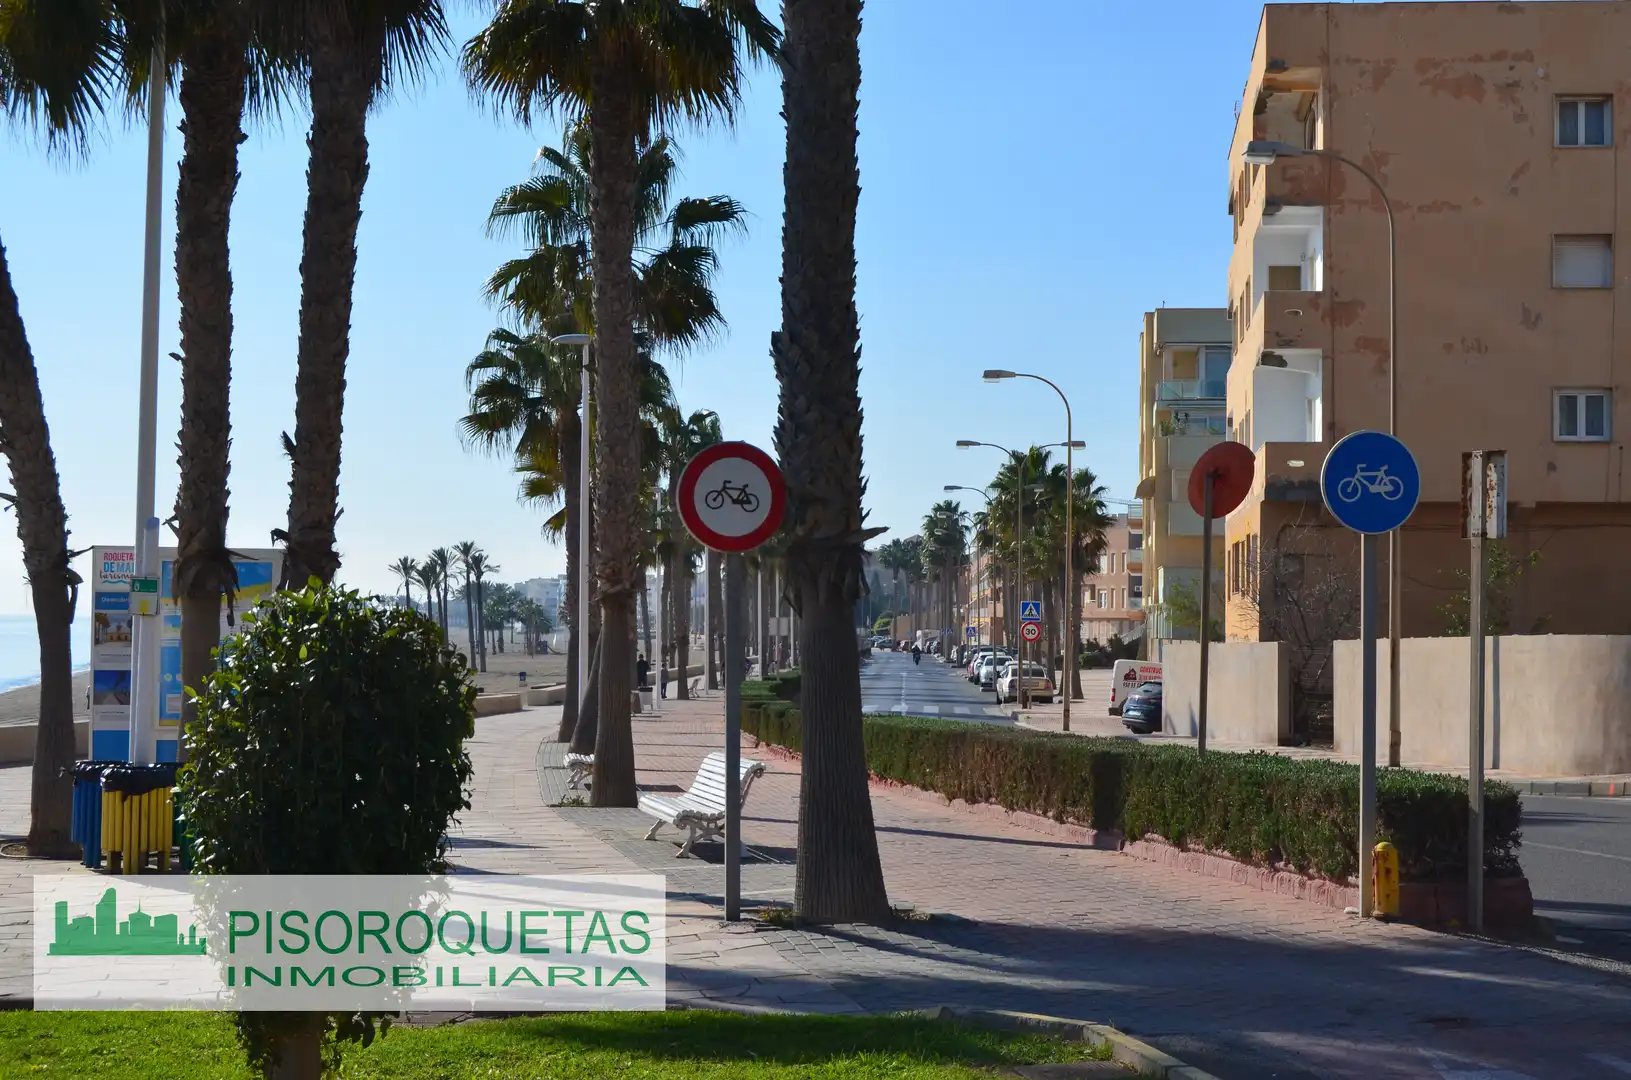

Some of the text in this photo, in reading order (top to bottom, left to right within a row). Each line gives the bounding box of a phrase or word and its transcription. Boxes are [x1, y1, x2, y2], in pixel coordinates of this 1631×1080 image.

[103, 552, 134, 561] ROQUETA
[103, 562, 115, 573] DE
[1025, 628, 1036, 636] 30
[1139, 666, 1162, 674] CONSTRUC
